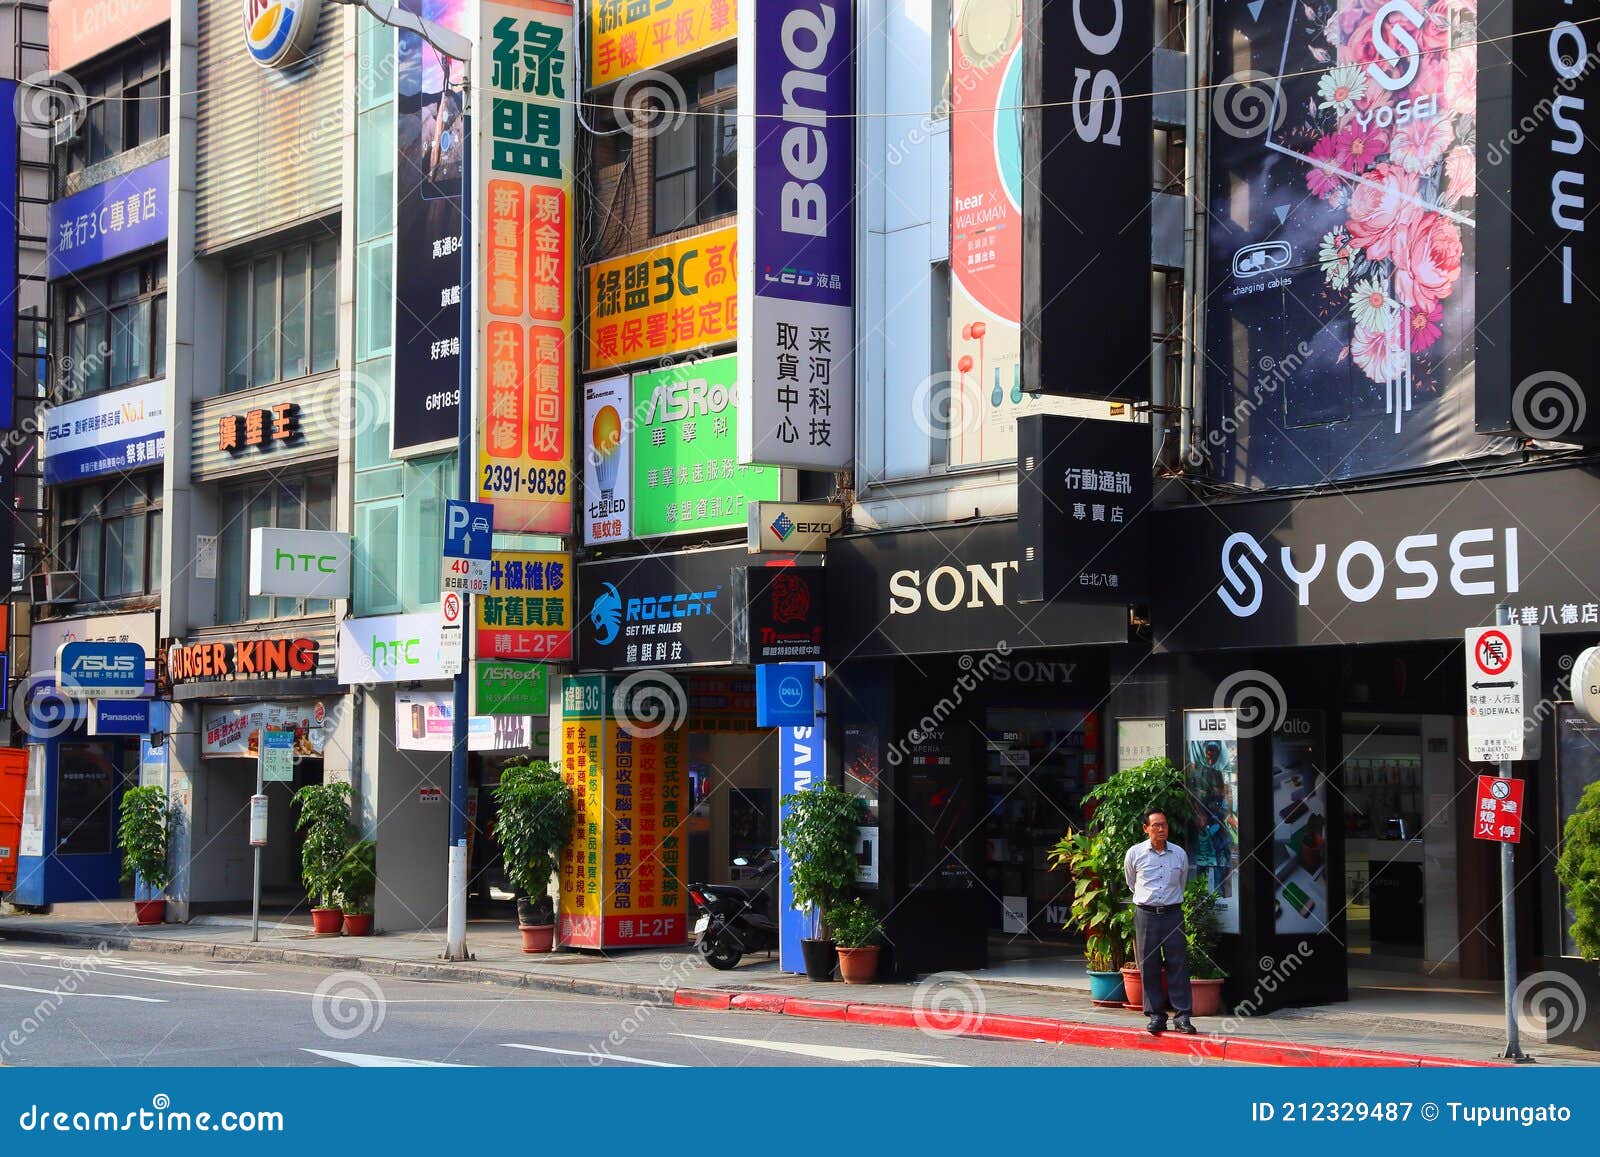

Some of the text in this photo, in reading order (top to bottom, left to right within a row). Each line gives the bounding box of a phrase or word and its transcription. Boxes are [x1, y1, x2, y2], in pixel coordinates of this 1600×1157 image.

[492, 16, 566, 179] 綠盟
[780, 3, 836, 238] BenQ
[1355, 94, 1438, 133] YOSEI
[1549, 0, 1588, 304] OSEI
[59, 187, 157, 252] 流行3C專賣店
[956, 204, 1007, 229] WALKMAN
[493, 189, 519, 309] 新舊買賣
[534, 194, 560, 314] 現金收購
[596, 249, 699, 319] 綠盟3C
[816, 273, 841, 289] 液晶
[1233, 277, 1292, 296] charging cables
[492, 329, 519, 450] 升級維修
[534, 335, 560, 454] 高價回收
[776, 322, 799, 444] 取貨中心
[809, 327, 831, 447] 采河科技
[218, 402, 293, 451] 漢堡王
[483, 464, 566, 495] 2391-9838
[1064, 467, 1132, 494] 行動通訊
[449, 505, 469, 540] P
[588, 498, 626, 519] 七盟LED
[1072, 502, 1125, 523] 專賣店
[592, 519, 622, 539] 驅蚊燈
[796, 522, 832, 534] EIZO
[451, 559, 470, 574] 40
[490, 560, 564, 591] 升級維修
[1079, 572, 1119, 588] 台北八德
[1280, 527, 1520, 606] YOSEI
[889, 560, 1018, 615] SON
[483, 595, 564, 626] 新舊買賣
[625, 586, 722, 622] ROCCAT
[494, 635, 559, 652] 請上2F
[626, 622, 682, 637] SET THE RULES
[72, 655, 136, 671] ASUS
[236, 637, 319, 673] KING
[482, 667, 541, 680] ASRock
[993, 661, 1078, 683] SONY
[565, 686, 599, 711] 綠盟3C
[781, 687, 801, 697] DELL
[101, 712, 145, 722] Panasonic
[1479, 707, 1521, 718] SIDEWALK
[618, 918, 674, 938] 請上2F
